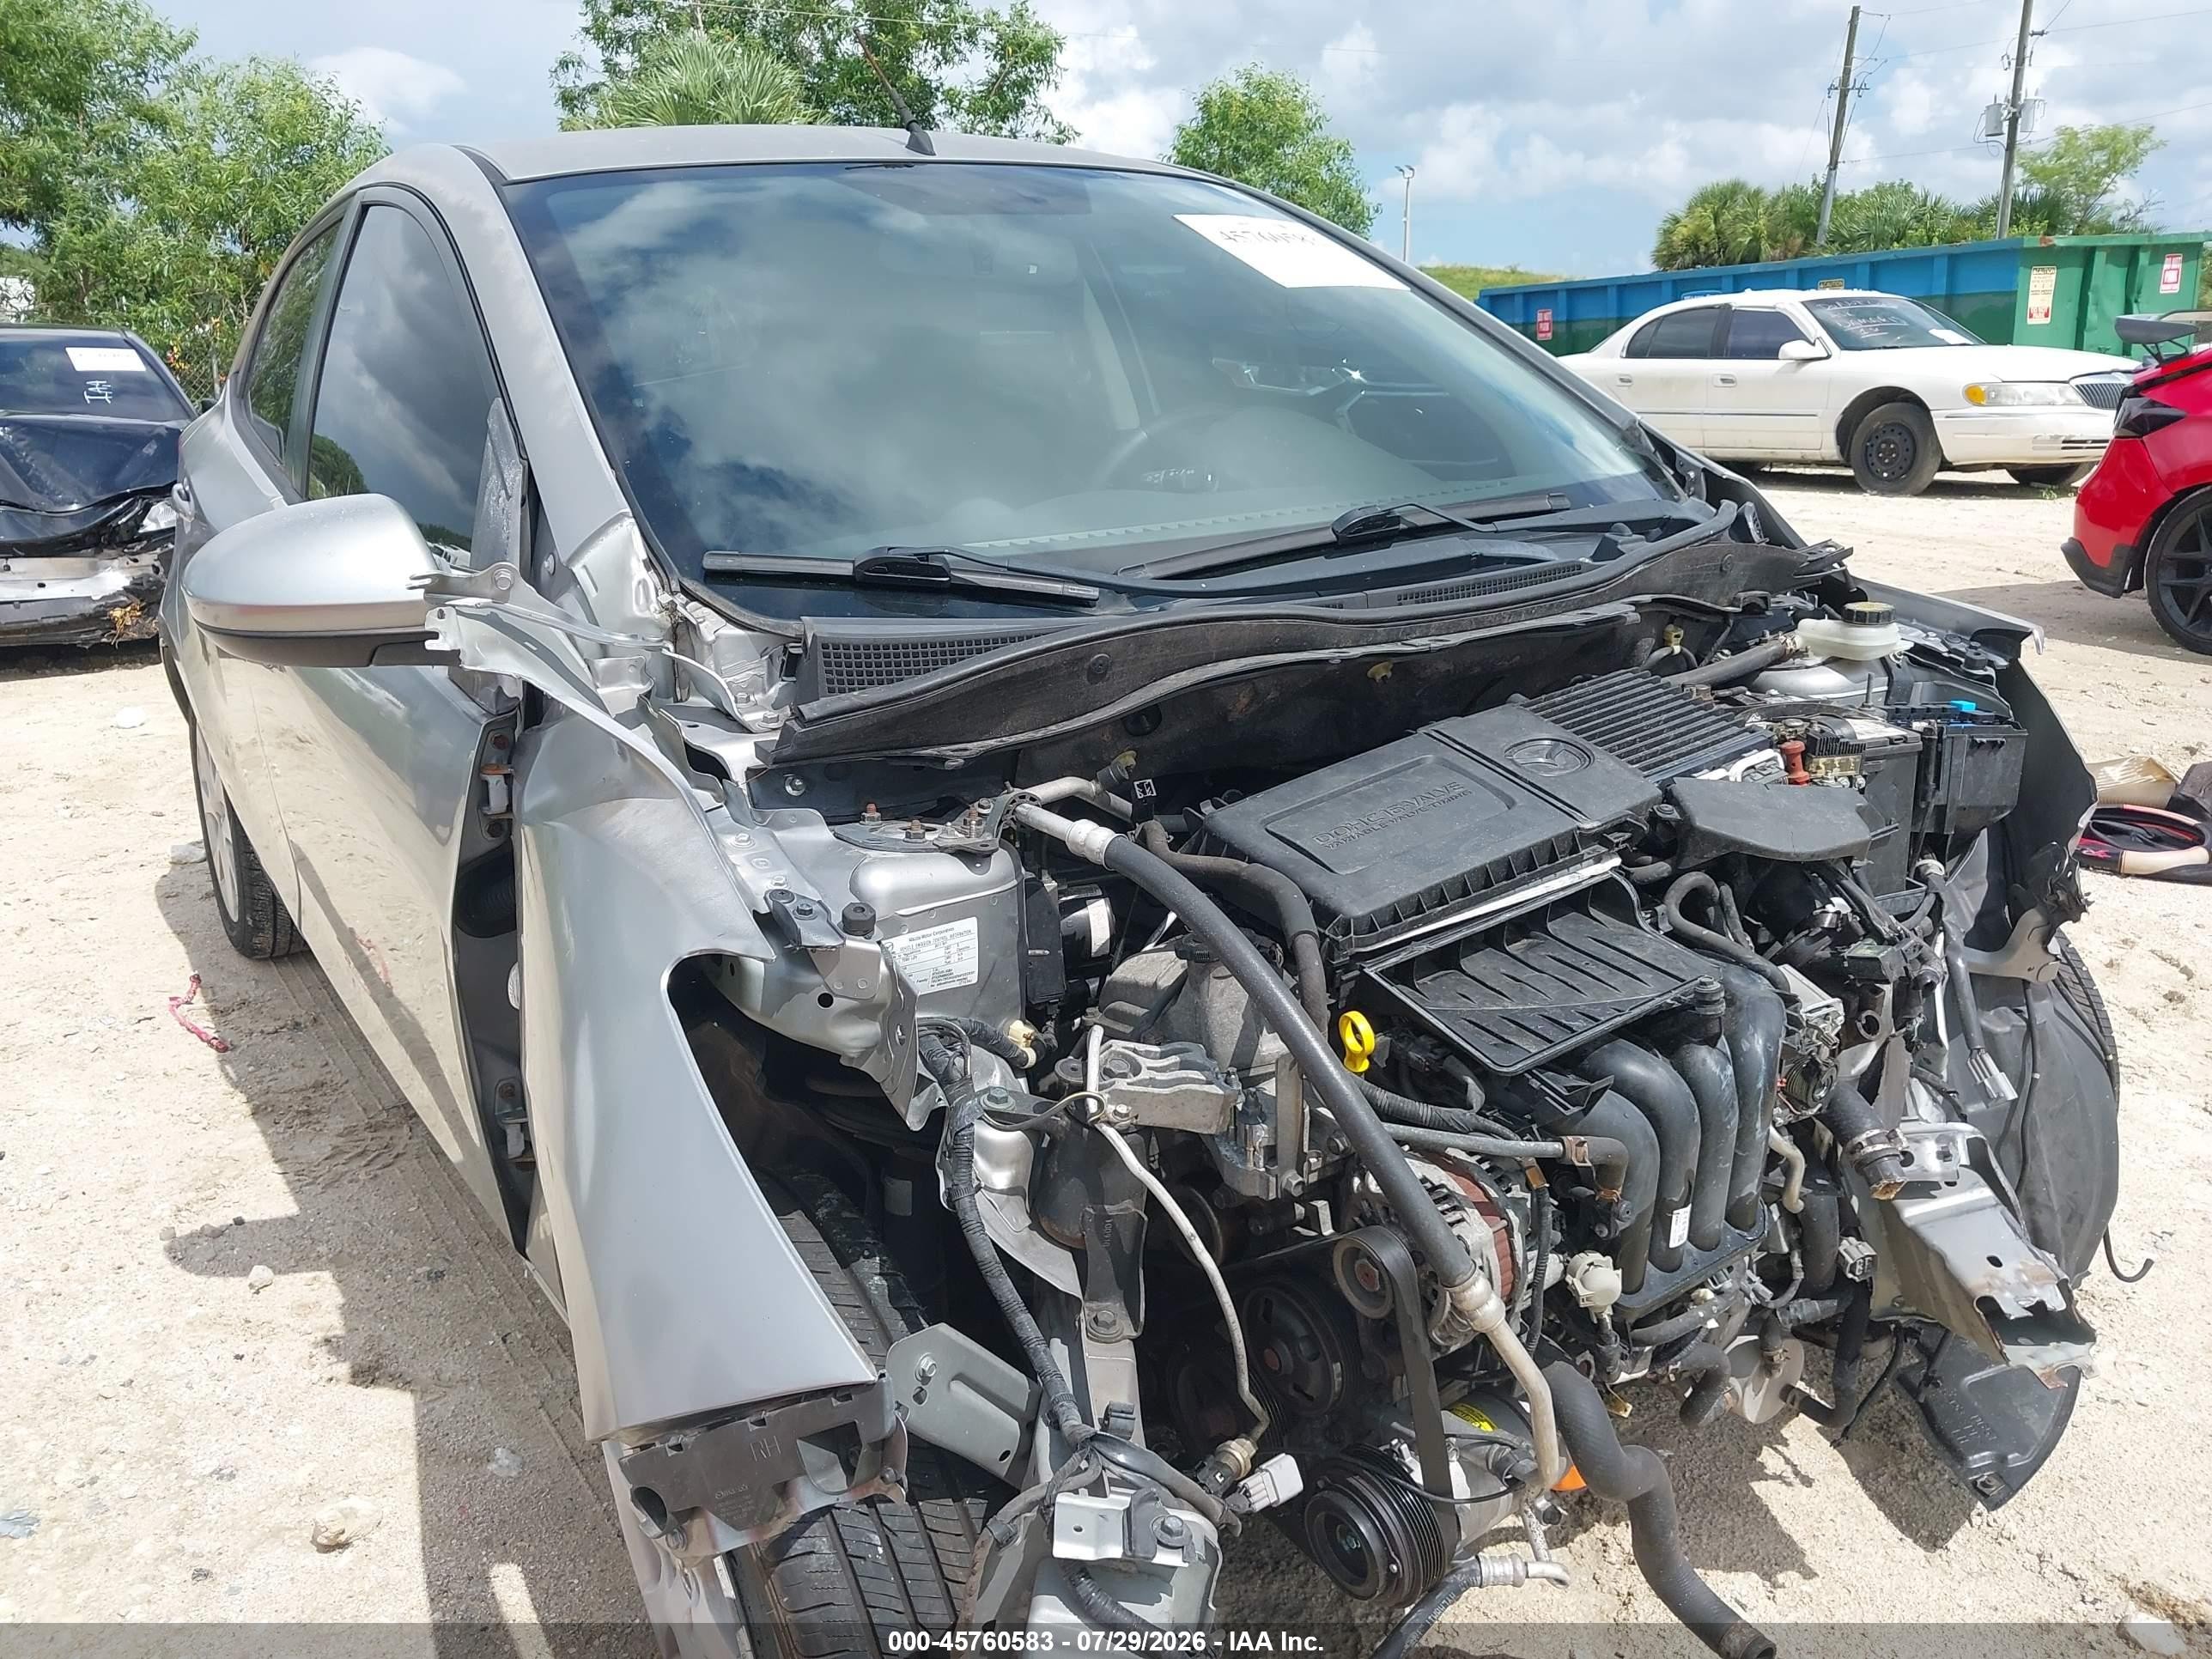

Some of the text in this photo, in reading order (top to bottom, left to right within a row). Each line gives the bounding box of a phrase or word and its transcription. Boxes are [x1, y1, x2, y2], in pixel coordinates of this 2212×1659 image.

[1324, 789, 1474, 850] VARIABLE VALVE TIMING
[750, 1435, 781, 1462] RH
